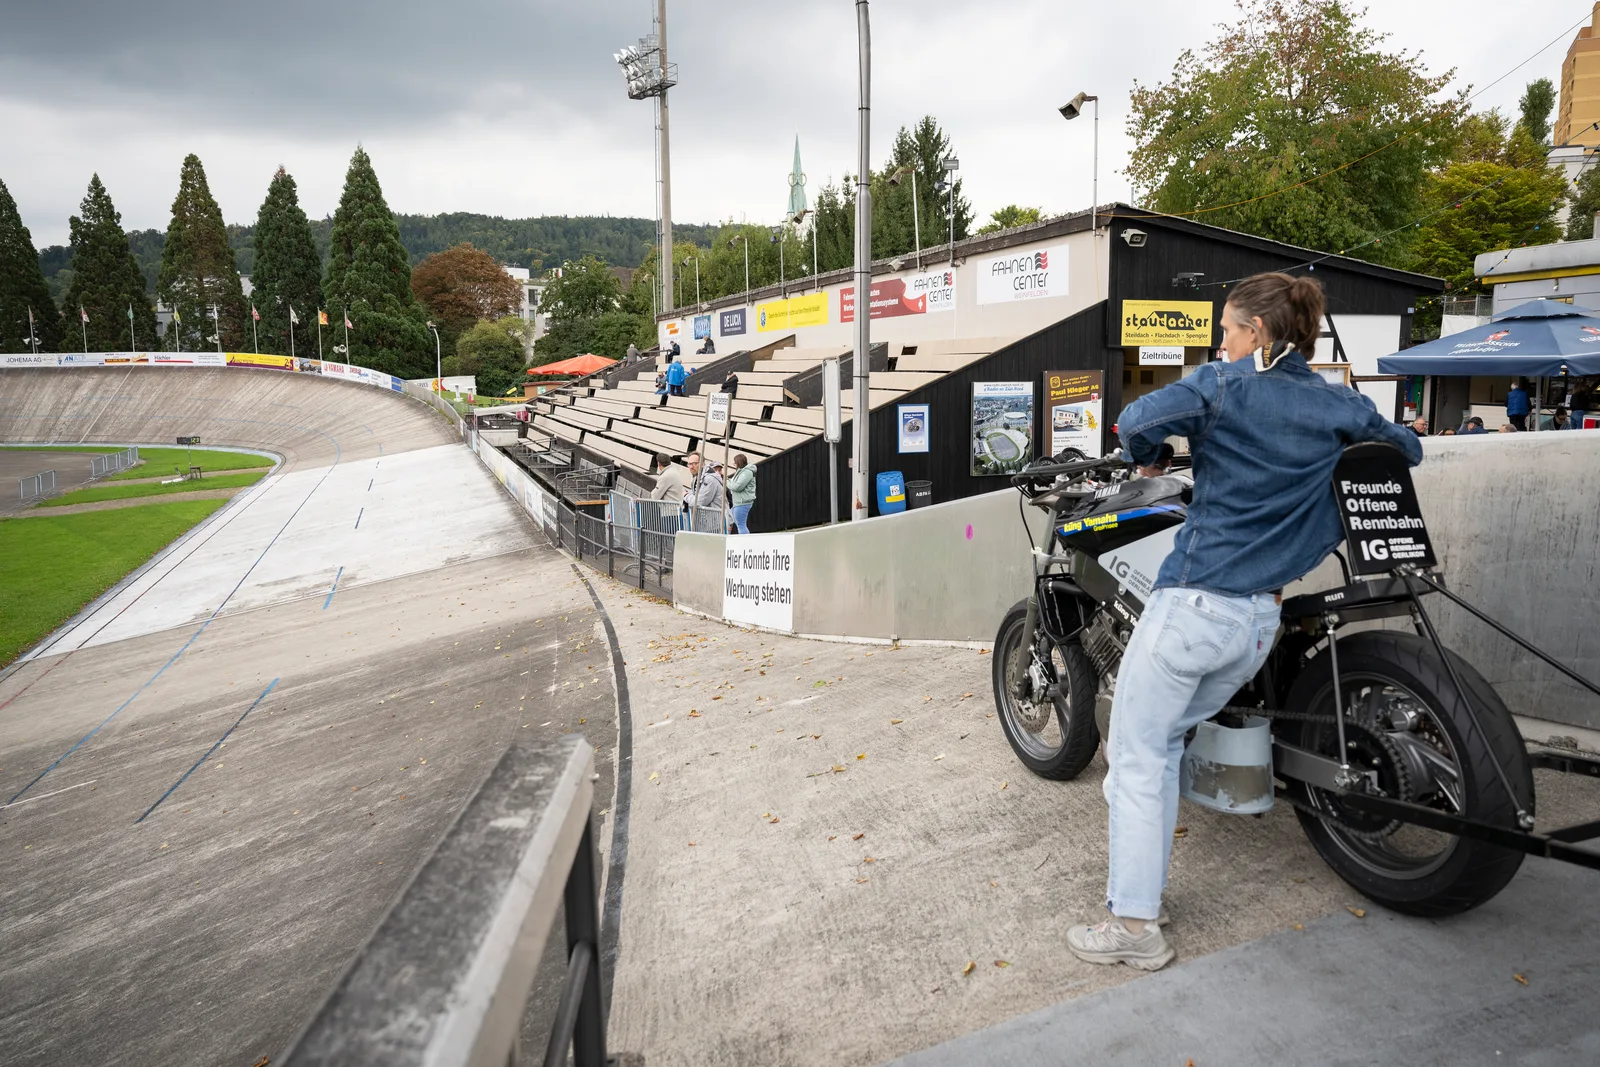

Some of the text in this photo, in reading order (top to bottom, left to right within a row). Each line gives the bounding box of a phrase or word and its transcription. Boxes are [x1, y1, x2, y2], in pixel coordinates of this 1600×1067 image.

[992, 256, 1032, 276] FAHNEN
[914, 275, 942, 291] FAHNEN
[1013, 272, 1049, 291] CENTER
[929, 288, 953, 303] CENTER
[1125, 313, 1209, 327] staudacher
[1141, 351, 1182, 360] Zieltribüne
[1051, 389, 1066, 397] Paul
[1094, 484, 1122, 499] YAMAHA
[1340, 480, 1403, 494] Freunde
[1346, 497, 1398, 513] Offene
[1083, 513, 1118, 527] Yamaha
[1349, 515, 1424, 530] Rennbahn
[1388, 537, 1414, 545] OFFENE
[1389, 543, 1426, 552] RENNBAHN
[1360, 539, 1389, 561] IG
[1392, 550, 1426, 559] OERLIKON
[726, 549, 790, 571] Hier könnte ihre
[1109, 555, 1131, 579] IG
[1130, 574, 1152, 592] RENNBA
[1133, 569, 1153, 586] OFFENE
[725, 577, 791, 606] Werbung stehen
